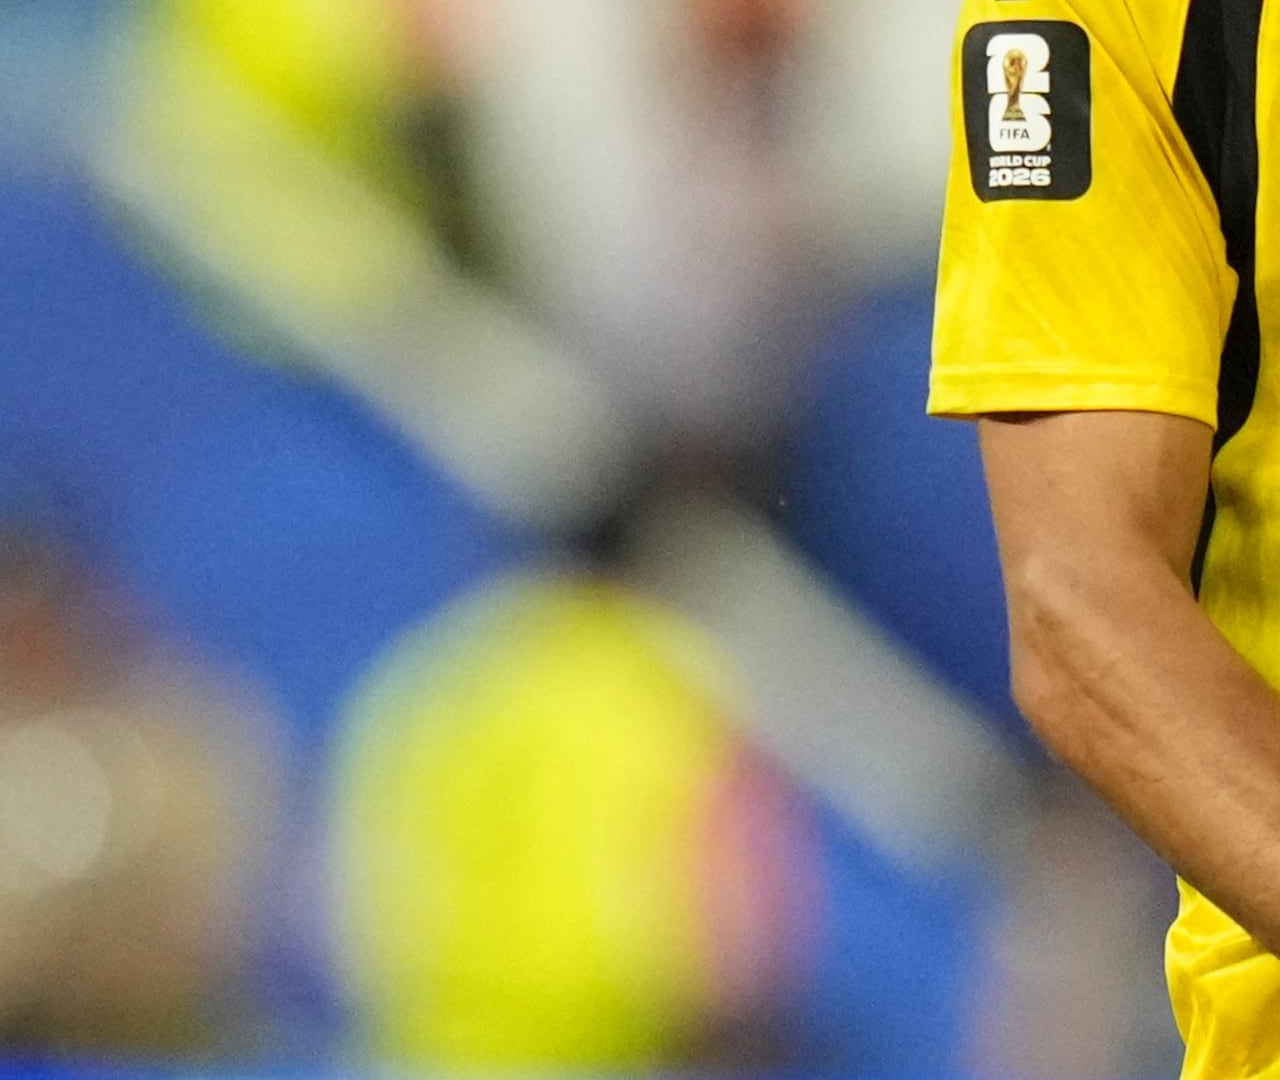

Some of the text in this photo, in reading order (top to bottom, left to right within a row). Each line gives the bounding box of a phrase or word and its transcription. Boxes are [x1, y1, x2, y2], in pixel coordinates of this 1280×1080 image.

[999, 128, 1031, 140] FIFA
[1024, 155, 1051, 167] CUP
[988, 168, 1051, 188] 2026
